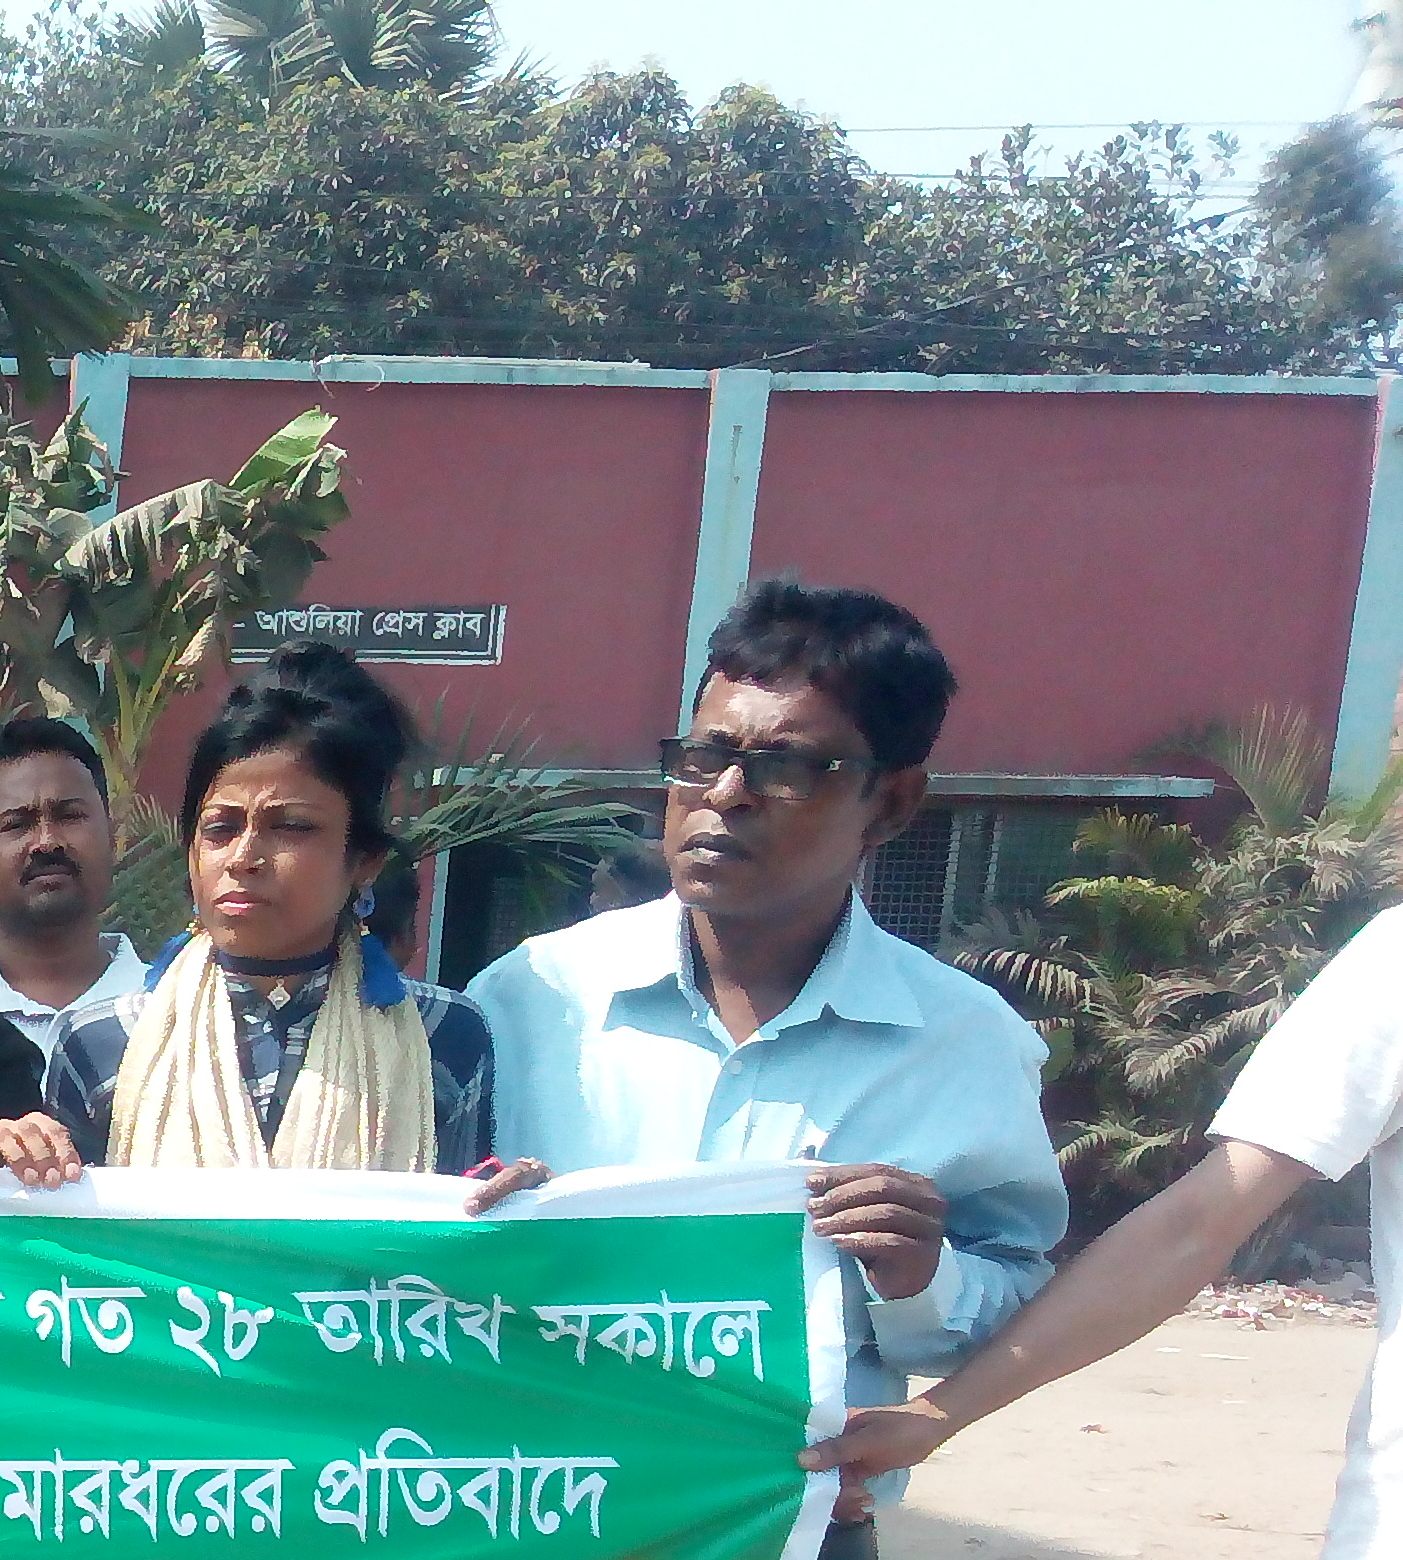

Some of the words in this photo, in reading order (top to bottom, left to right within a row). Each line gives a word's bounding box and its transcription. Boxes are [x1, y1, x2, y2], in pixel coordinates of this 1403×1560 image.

[254, 603, 364, 637] আশুলিয়া
[372, 609, 428, 638] প্রেস
[432, 610, 487, 640] ক্লাব
[26, 1276, 147, 1368] গত
[170, 1286, 274, 1377] ২৮
[293, 1274, 516, 1365] তারিখ
[531, 1290, 772, 1382] সকালে
[313, 1427, 621, 1543] প্রতিবাদে
